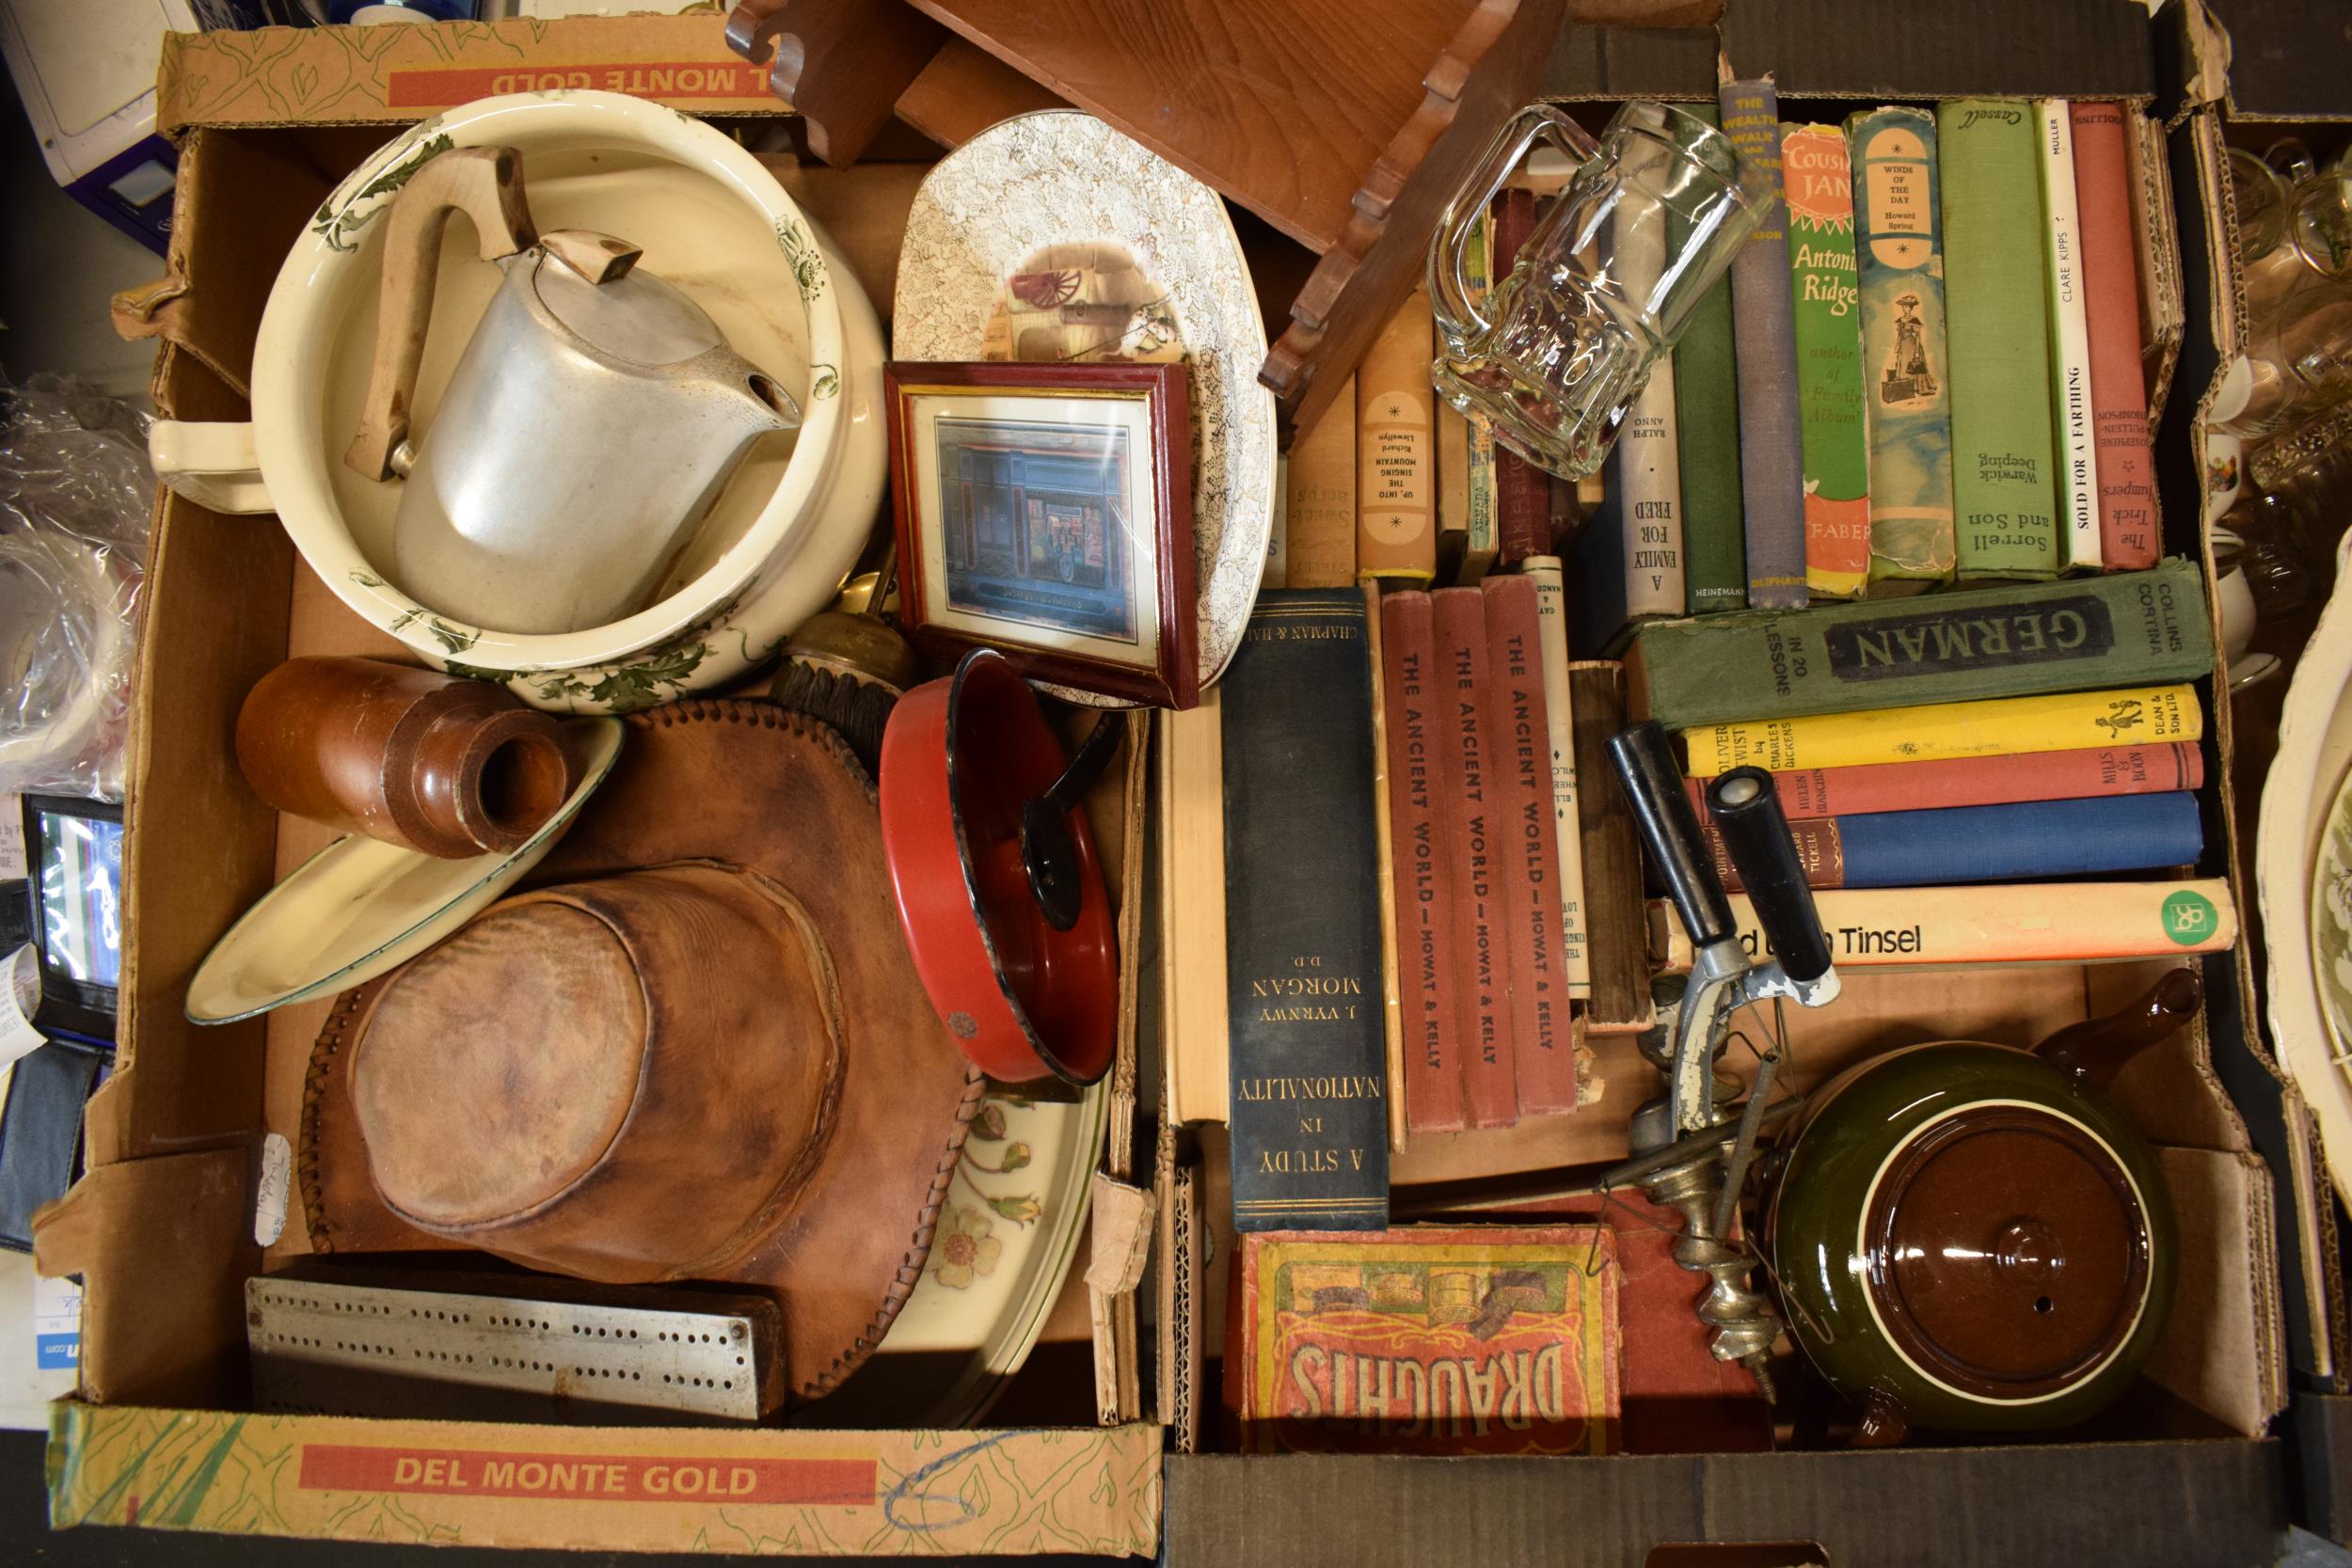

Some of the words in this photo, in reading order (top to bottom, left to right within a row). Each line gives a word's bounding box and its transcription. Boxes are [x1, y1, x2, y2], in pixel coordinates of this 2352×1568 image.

[1735, 97, 1764, 111] THE
[1724, 115, 1777, 130] WEALTH
[1958, 109, 2023, 130] Cassell
[2075, 115, 2122, 124] COLLINS
[2050, 119, 2060, 155] MULLER
[1884, 212, 1915, 220] Howard
[1888, 222, 1914, 230] Spring
[2058, 231, 2070, 261] KIPPS
[1804, 274, 1858, 316] Ridge
[2061, 266, 2073, 303] CLARE
[1809, 345, 1853, 359] author
[1826, 367, 1840, 382] of
[2069, 367, 2084, 436] FARTHING
[1633, 418, 1664, 426] ANNO
[1378, 432, 1414, 442] Llewellyn
[1633, 429, 1666, 438] RALPH
[2074, 444, 2085, 452] A
[1979, 452, 2036, 470] Deeping
[1979, 470, 2038, 483] Warwick
[2074, 459, 2088, 486] FOR
[1635, 501, 1672, 519] FRED
[2076, 492, 2090, 530] SOLD
[2113, 509, 2150, 526] Trick
[1811, 523, 1871, 541] FABER
[1968, 514, 2009, 530] Son
[2018, 514, 2050, 529] and
[1641, 527, 1669, 543] FOR
[1974, 534, 2048, 552] Sorrell
[2121, 533, 2146, 549] The
[1633, 550, 1677, 568] FAMILY
[1651, 575, 1663, 592] A
[2138, 584, 2163, 656] CORTINA
[2158, 584, 2183, 652] COLLINS
[1274, 626, 1287, 639] &
[1292, 626, 1359, 641] CHAPMAN
[1855, 610, 2087, 670] GERMAN
[1508, 635, 1525, 676] THE
[1788, 637, 1804, 652] IN
[1455, 647, 1473, 689] THE
[1764, 624, 1791, 696] LESSONS
[1792, 657, 1808, 677] 20
[1403, 654, 1421, 695] THE
[2151, 694, 2161, 703] &
[2153, 706, 2165, 736] DEAN
[2169, 713, 2181, 735] SON
[1512, 690, 1536, 789] ANCIENT
[1715, 723, 1730, 774] OLIVER
[1753, 740, 1765, 753] by
[1767, 723, 1781, 769] CHARLES
[1781, 721, 1795, 768] DICKENS
[1406, 707, 1428, 808] ANCIENT
[1459, 703, 1483, 802] ANCIENT
[2099, 752, 2116, 784] MILLS
[2129, 752, 2146, 782] BOON
[1794, 775, 1811, 810] HELEN
[1806, 832, 1820, 874] TICKELL
[1531, 911, 1548, 972] MOWAT
[1838, 926, 1921, 954] Tinsel
[1421, 929, 1436, 991] MOWAT
[1476, 925, 1492, 987] MOWAT
[1252, 977, 1361, 997] MORGAN
[1535, 982, 1549, 992] &
[1424, 1000, 1438, 1011] &
[1480, 996, 1493, 1006] &
[1260, 1007, 1340, 1022] VYRNWY
[1344, 1006, 1356, 1020] J.
[1537, 1002, 1553, 1050] KELLY
[1425, 1020, 1440, 1069] KELLY
[1481, 1015, 1496, 1065] KELLY
[1238, 1076, 1380, 1101] NATIONALITY
[1299, 1117, 1323, 1132] IN
[1260, 1149, 1339, 1173] STUDY
[1350, 1148, 1363, 1171] A
[1289, 1342, 1565, 1438] DRAUGHTS
[394, 1457, 468, 1488] DEL
[482, 1463, 627, 1493] MONTE
[643, 1466, 757, 1496] GOLD
